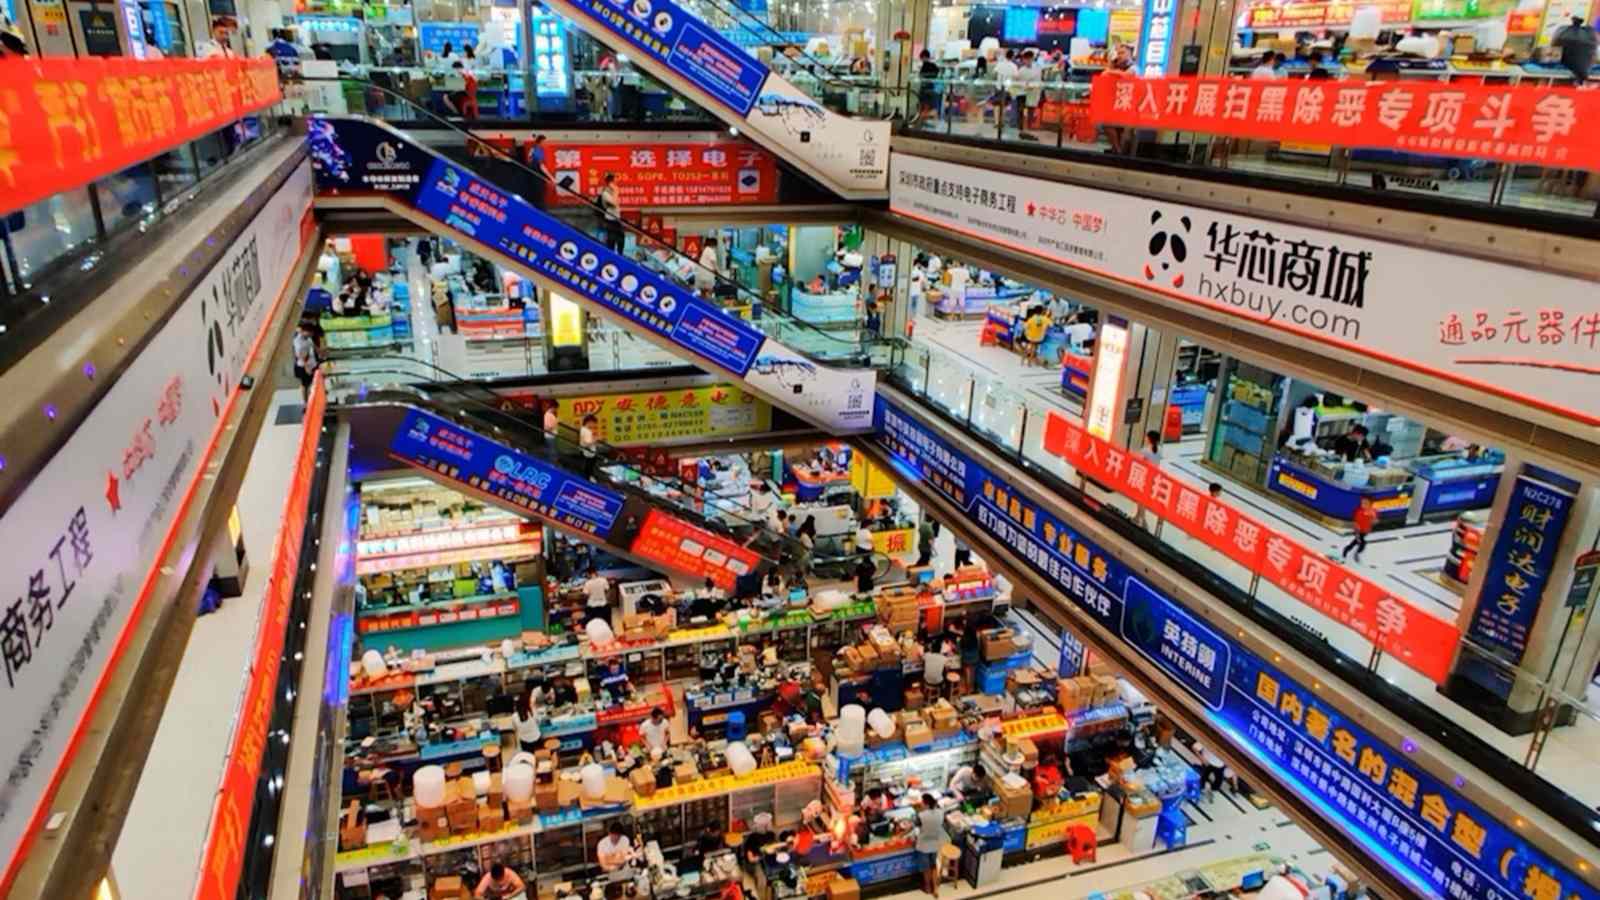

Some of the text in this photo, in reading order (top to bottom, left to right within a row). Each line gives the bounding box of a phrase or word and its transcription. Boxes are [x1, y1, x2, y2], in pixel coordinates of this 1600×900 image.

[1112, 81, 1577, 143] 深入开展扫黑除恶专项斗争
[554, 149, 762, 168] 第一选择电子
[1204, 221, 1373, 309] 华芯商城
[1198, 272, 1361, 341] hxbuy.com
[1439, 310, 1600, 349] 通品元器件
[1064, 426, 1408, 635] 深入开展扫黑除恶专项斗争
